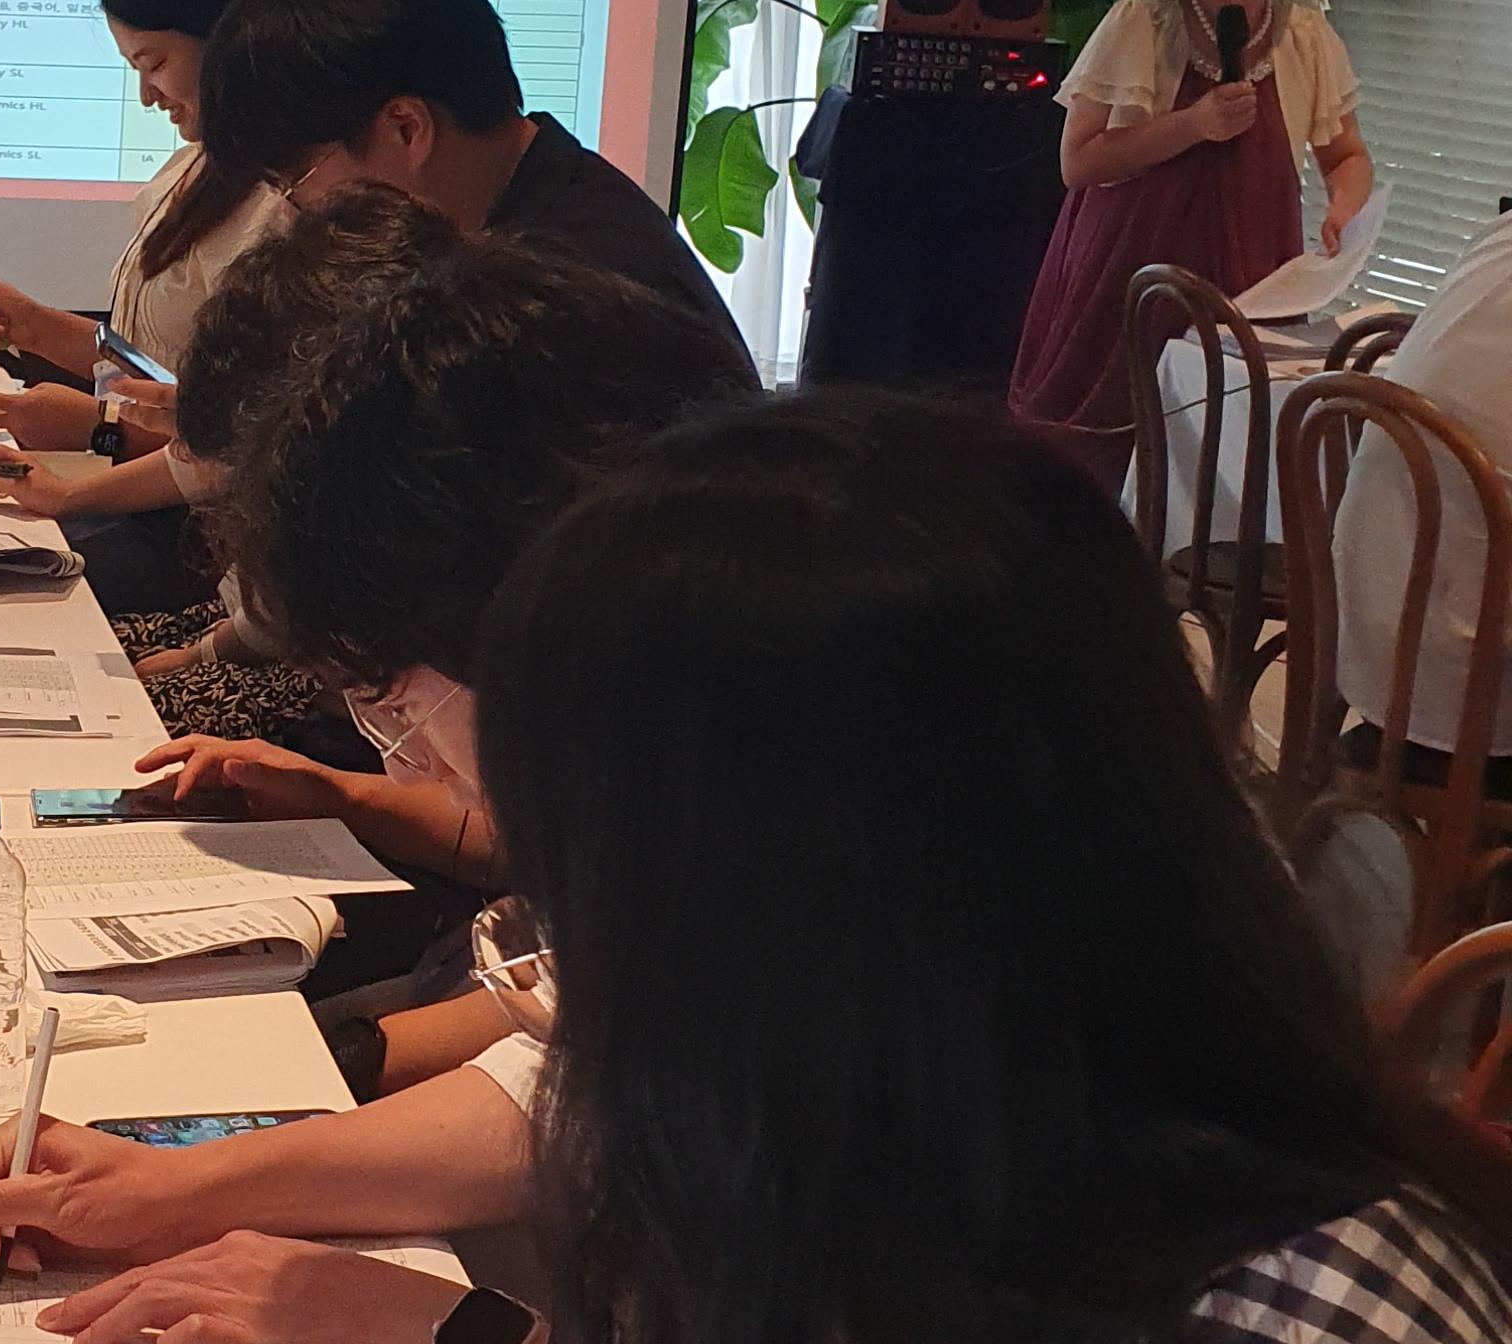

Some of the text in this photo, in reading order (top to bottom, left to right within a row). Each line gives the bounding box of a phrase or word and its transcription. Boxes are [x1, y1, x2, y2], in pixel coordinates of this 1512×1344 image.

[12, 19, 29, 29] HL
[9, 68, 24, 78] SL
[29, 101, 46, 111] HL
[27, 150, 42, 160] SL
